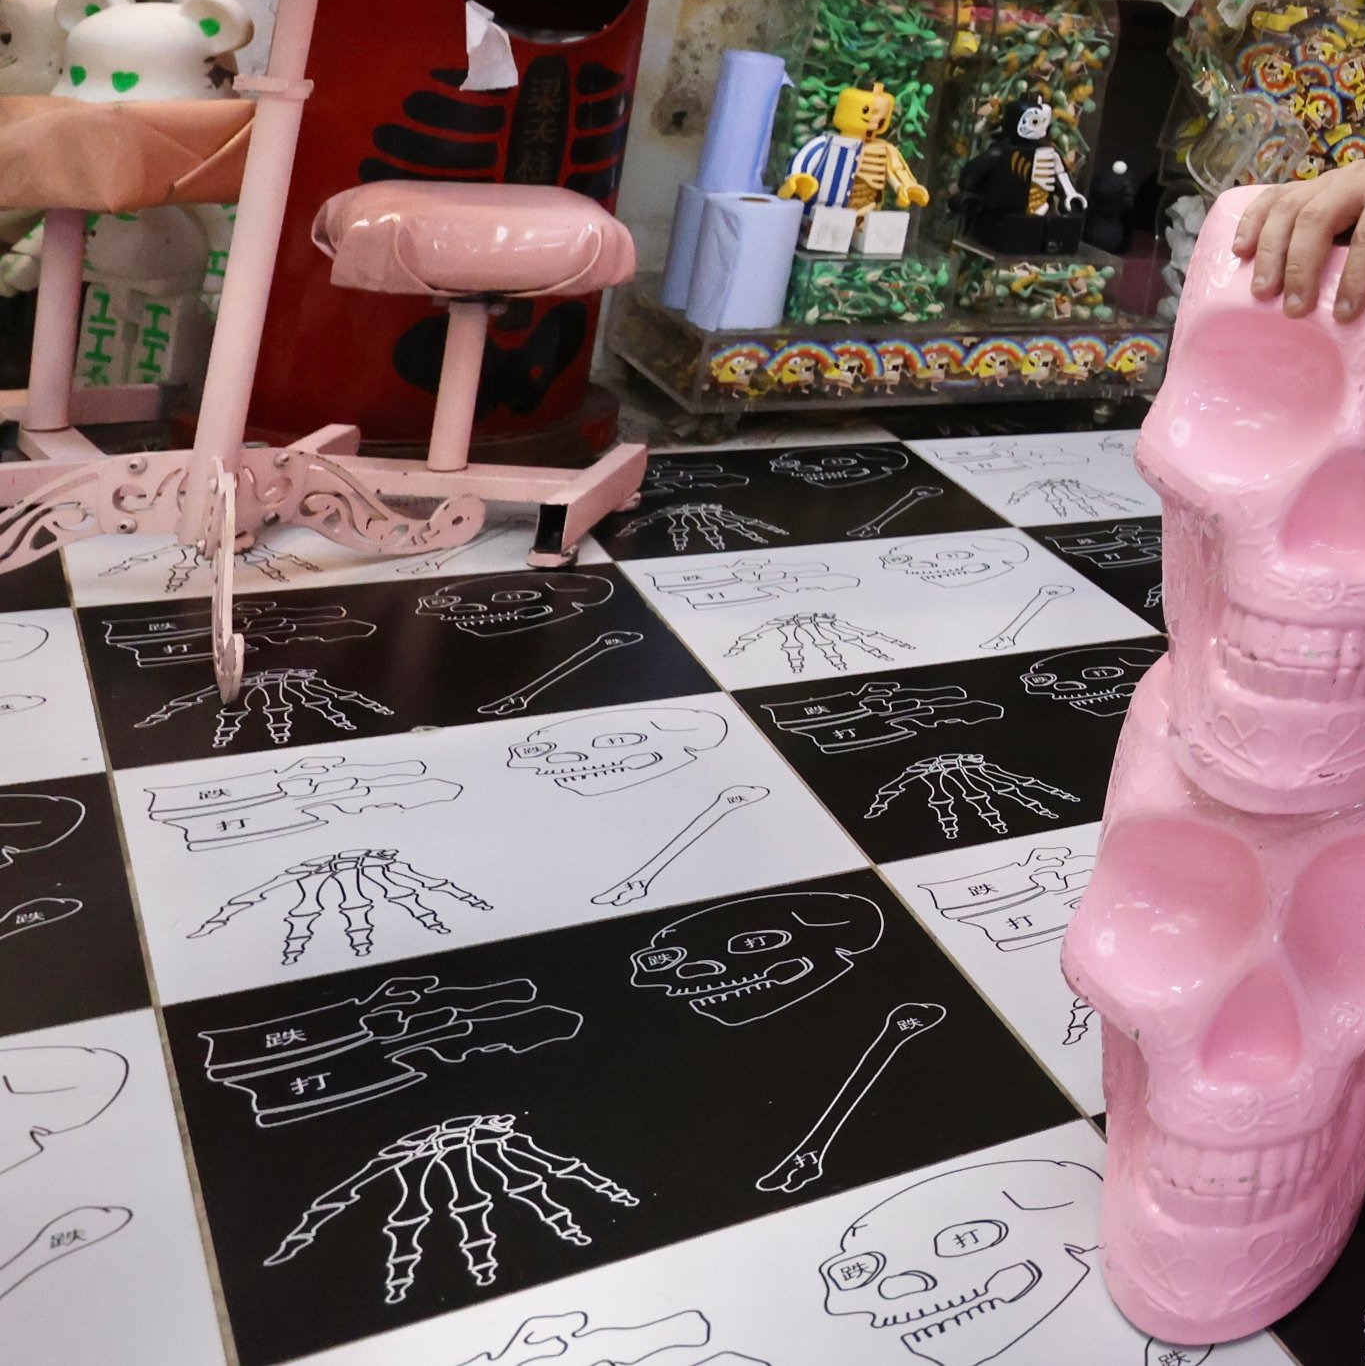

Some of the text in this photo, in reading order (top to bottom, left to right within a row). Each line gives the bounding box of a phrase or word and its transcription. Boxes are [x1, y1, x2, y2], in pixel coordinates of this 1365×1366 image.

[149, 623, 176, 631] 跌
[165, 645, 187, 653] 打
[804, 706, 830, 715] 跌
[833, 729, 855, 739] 打
[524, 746, 543, 755] 跌
[199, 789, 226, 800] 跌
[215, 817, 247, 832] 打
[968, 884, 995, 896] 跌
[16, 912, 44, 924] 跌
[1008, 916, 1032, 929] 打
[744, 936, 766, 948] 打
[648, 954, 669, 965] 跌
[897, 1018, 923, 1031] 跌
[266, 1029, 306, 1048] 跌
[290, 1073, 331, 1094] 打
[793, 1151, 818, 1168] 打
[50, 1229, 83, 1248] 跌
[954, 1229, 979, 1248] 打
[841, 1263, 867, 1281] 跌
